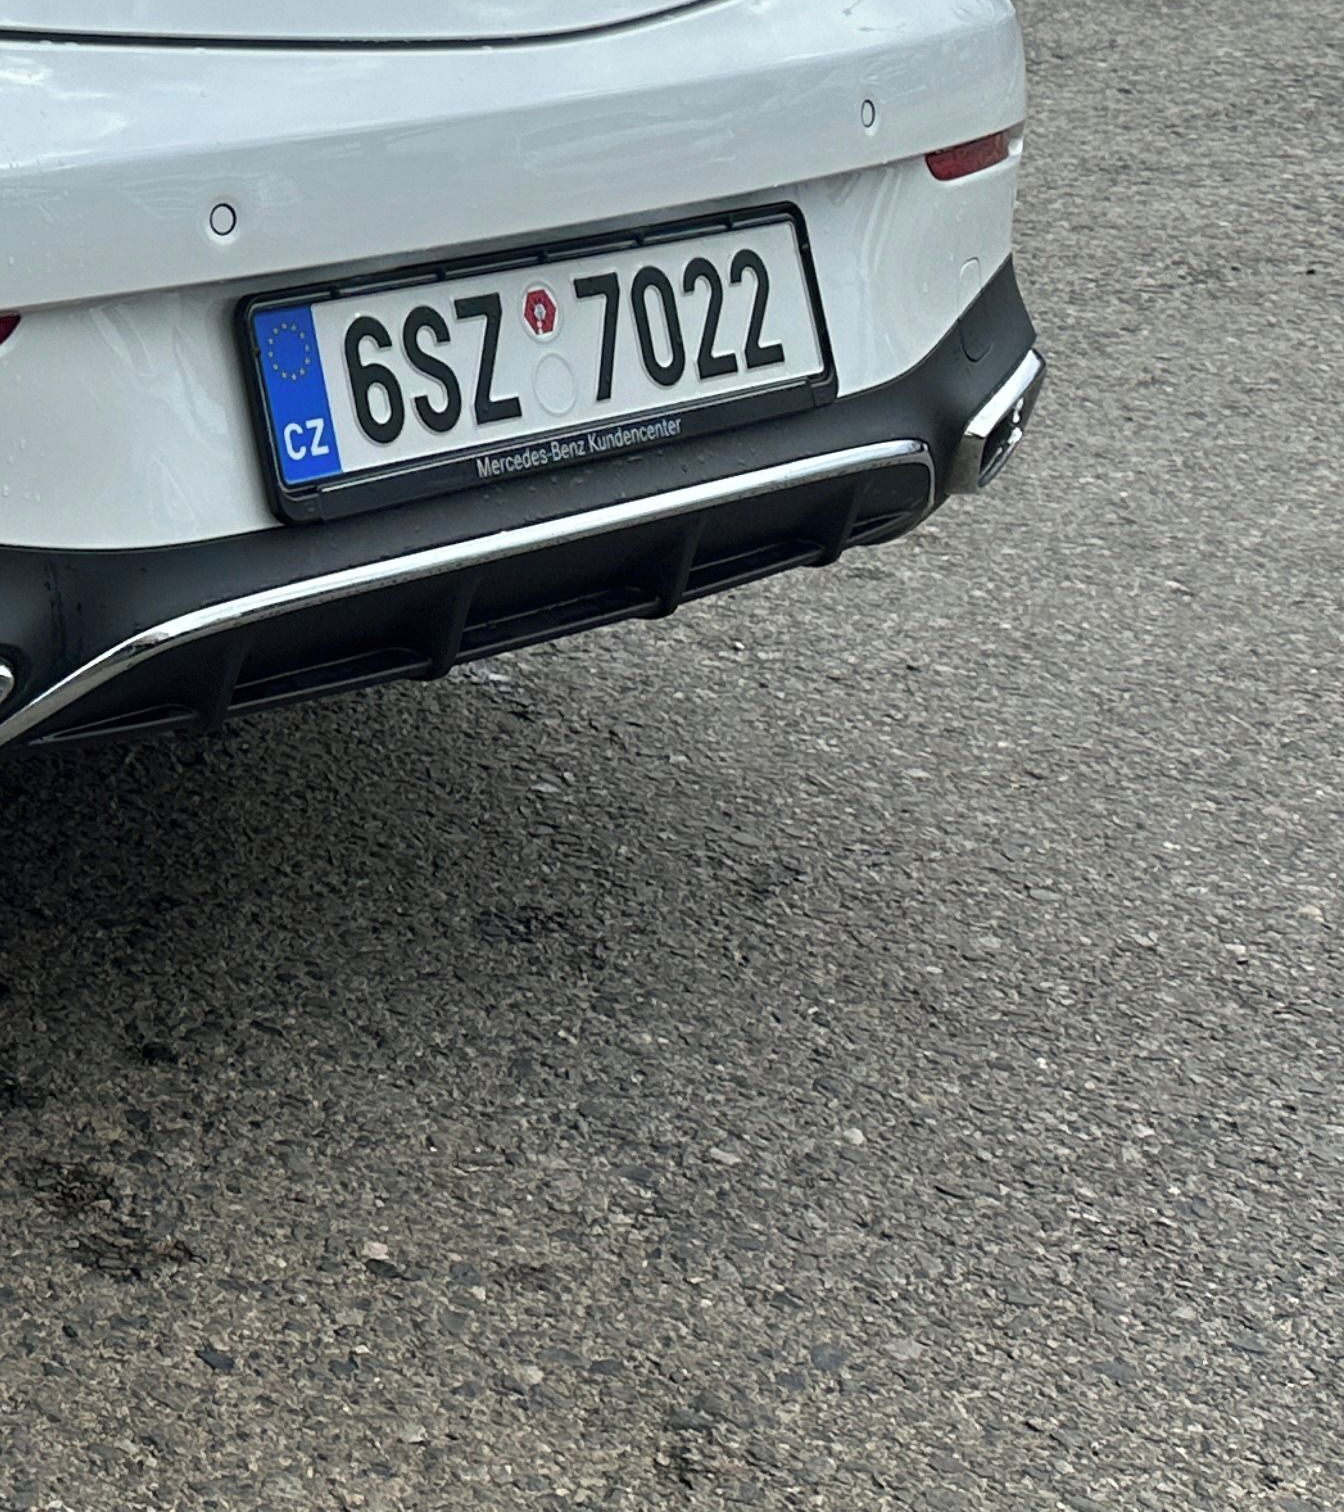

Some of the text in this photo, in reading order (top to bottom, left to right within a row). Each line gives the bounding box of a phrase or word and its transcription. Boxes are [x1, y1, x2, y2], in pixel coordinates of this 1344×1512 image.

[343, 248, 786, 446] 6SZ 7022
[282, 418, 328, 461] CZ
[476, 417, 682, 478] Mercedes-Benz Kundencenter
